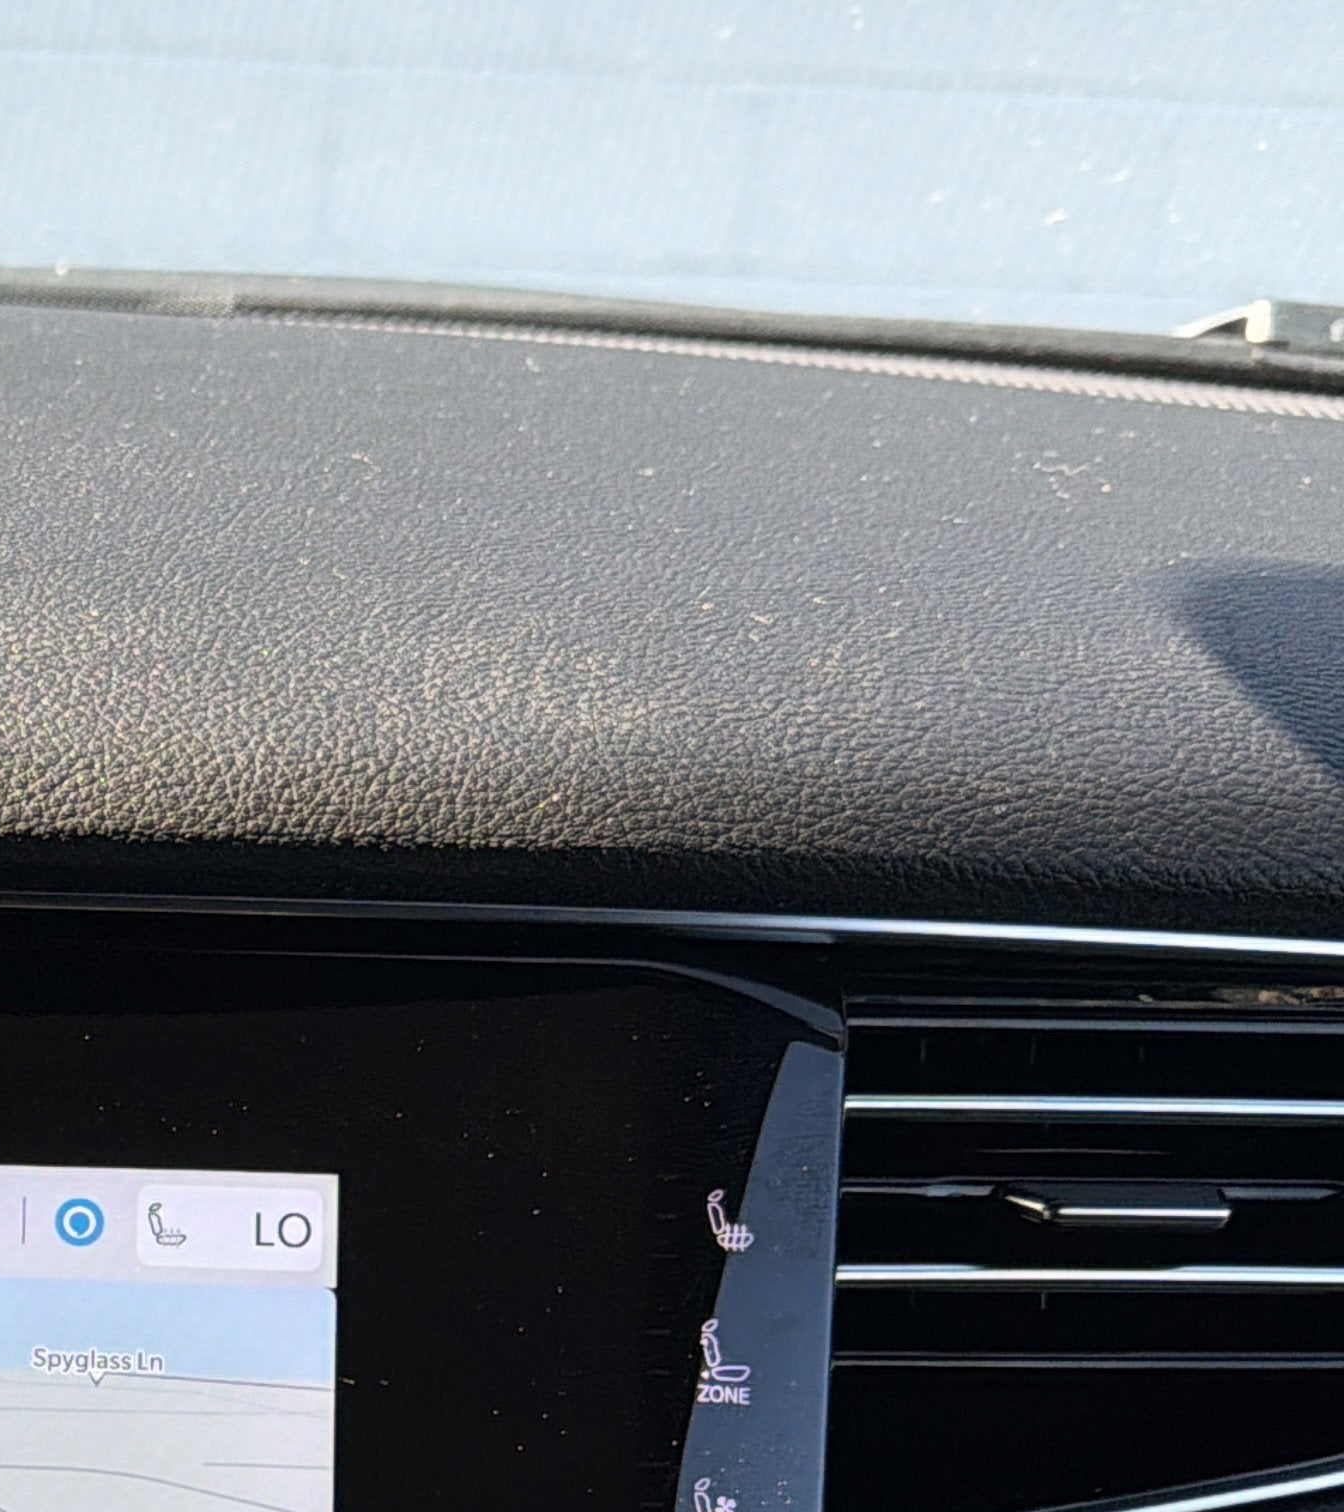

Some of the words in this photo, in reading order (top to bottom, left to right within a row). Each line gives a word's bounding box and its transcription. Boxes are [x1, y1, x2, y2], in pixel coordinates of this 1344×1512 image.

[255, 1212, 313, 1248] LO
[32, 1348, 131, 1376] Spyglass
[136, 1351, 164, 1374] Ln
[697, 1385, 750, 1404] ZONE
